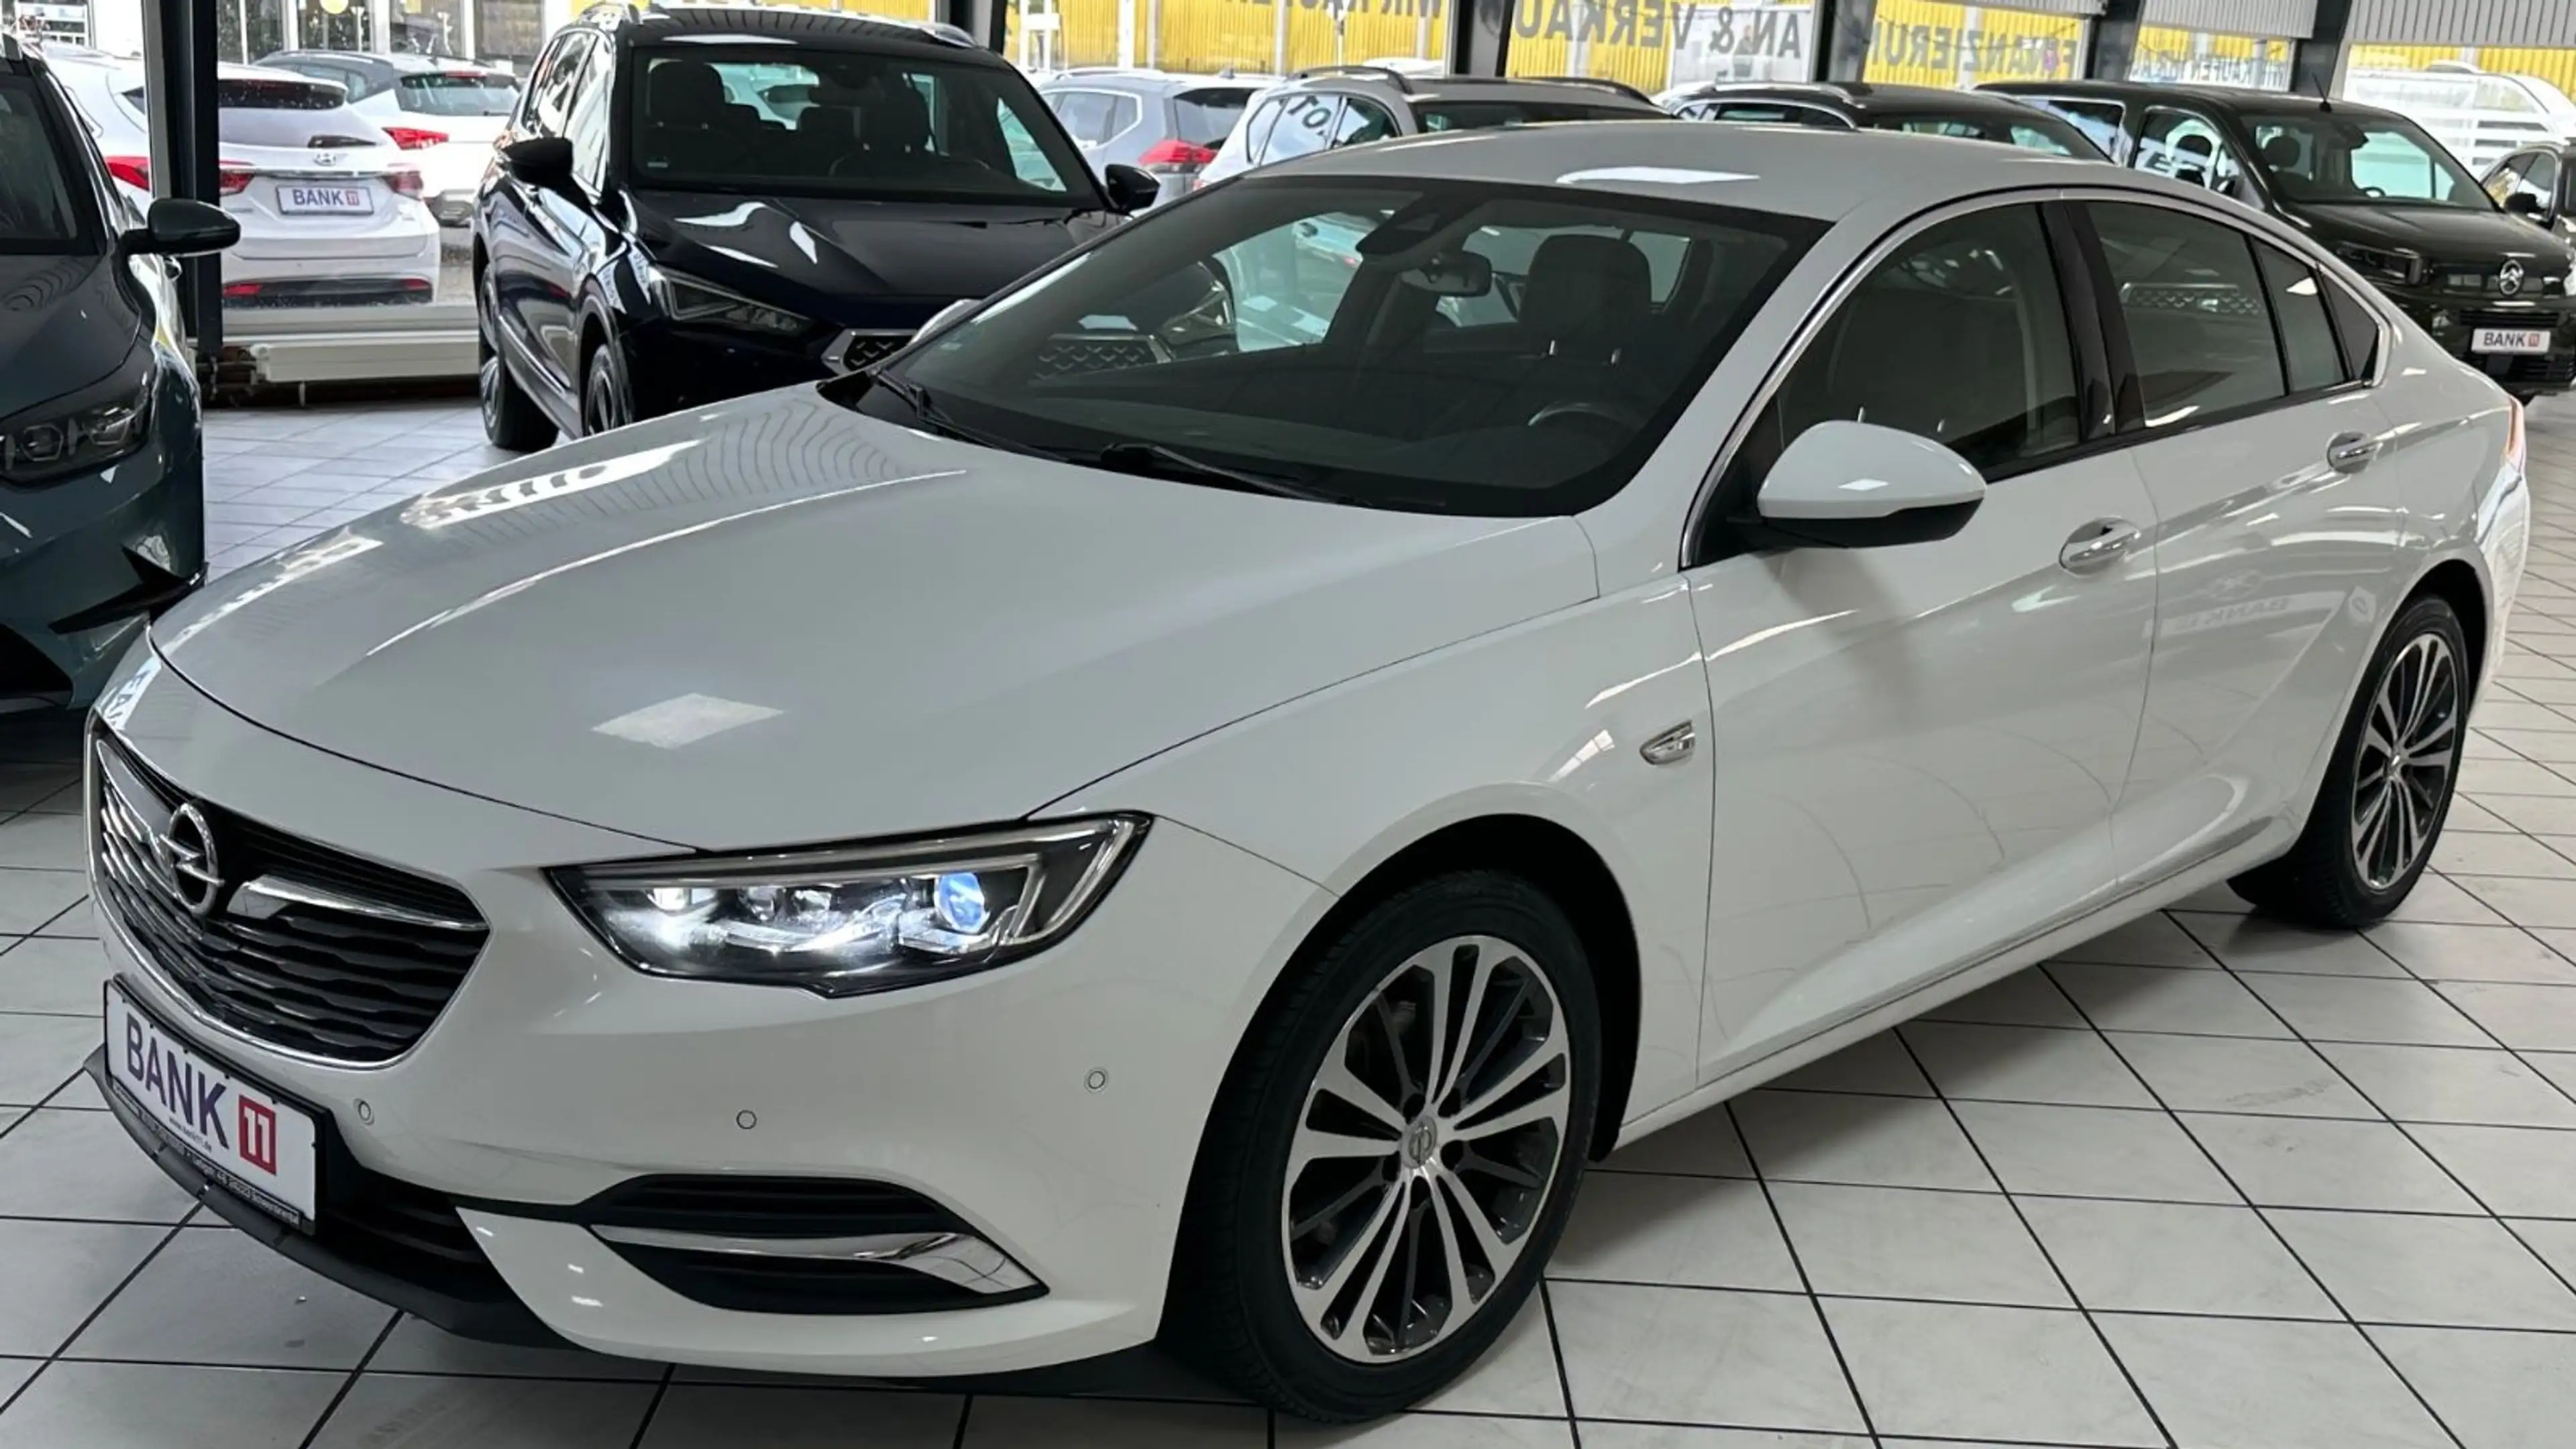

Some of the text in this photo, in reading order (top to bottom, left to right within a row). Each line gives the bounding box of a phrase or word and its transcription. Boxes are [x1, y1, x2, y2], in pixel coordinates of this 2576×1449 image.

[292, 189, 343, 206] BANK
[2483, 332, 2525, 347] BANK
[127, 1012, 229, 1150] BANK
[241, 1102, 273, 1168] 11
